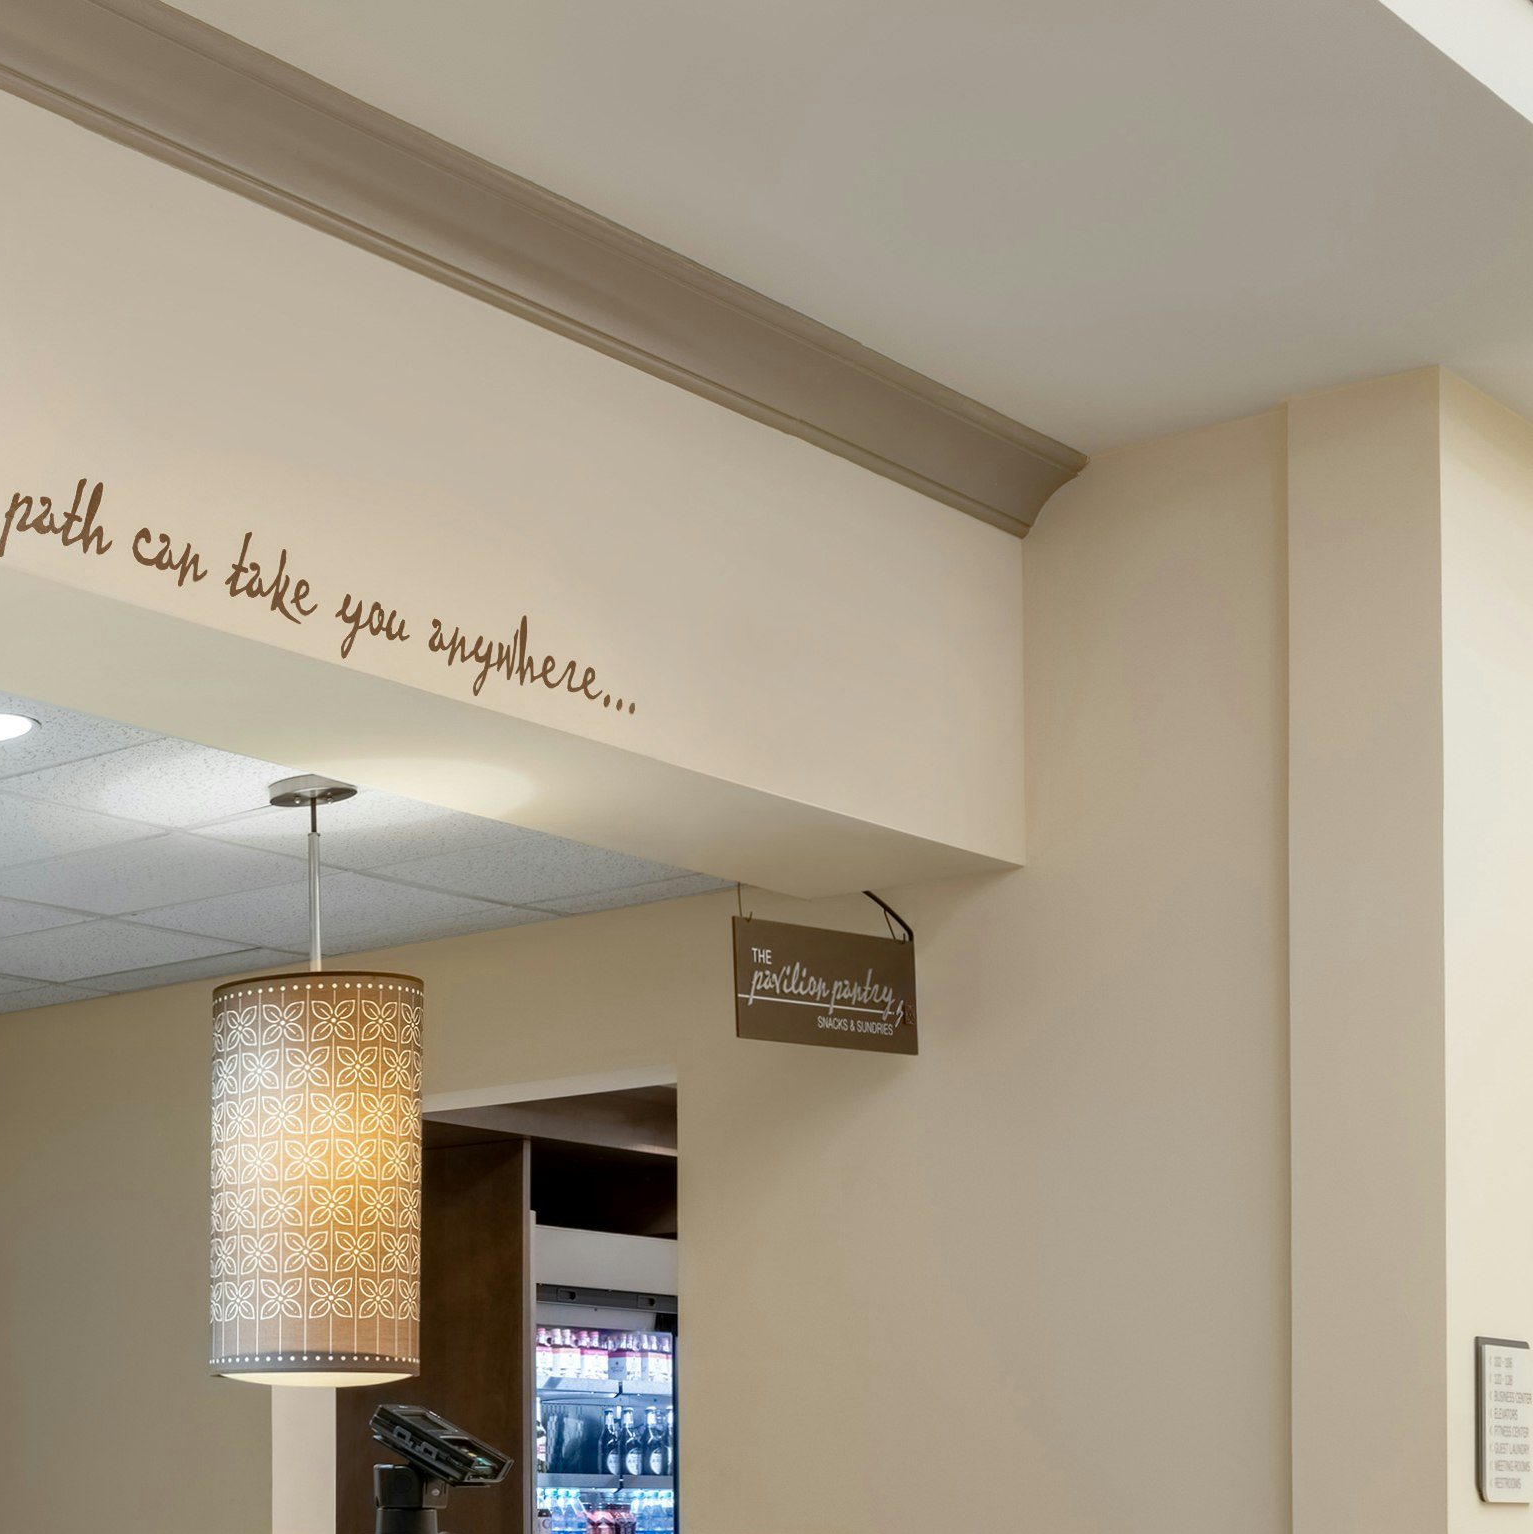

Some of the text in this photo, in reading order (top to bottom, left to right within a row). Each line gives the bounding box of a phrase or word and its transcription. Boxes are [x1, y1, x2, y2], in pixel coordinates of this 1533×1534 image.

[132, 527, 209, 588] can
[225, 532, 319, 625] take
[335, 593, 411, 660] you
[427, 615, 636, 715] anywhere...
[751, 947, 773, 965] THE
[747, 961, 897, 1021] pavilion pantry
[817, 1015, 894, 1036] SNACKS & SUNDRIES
